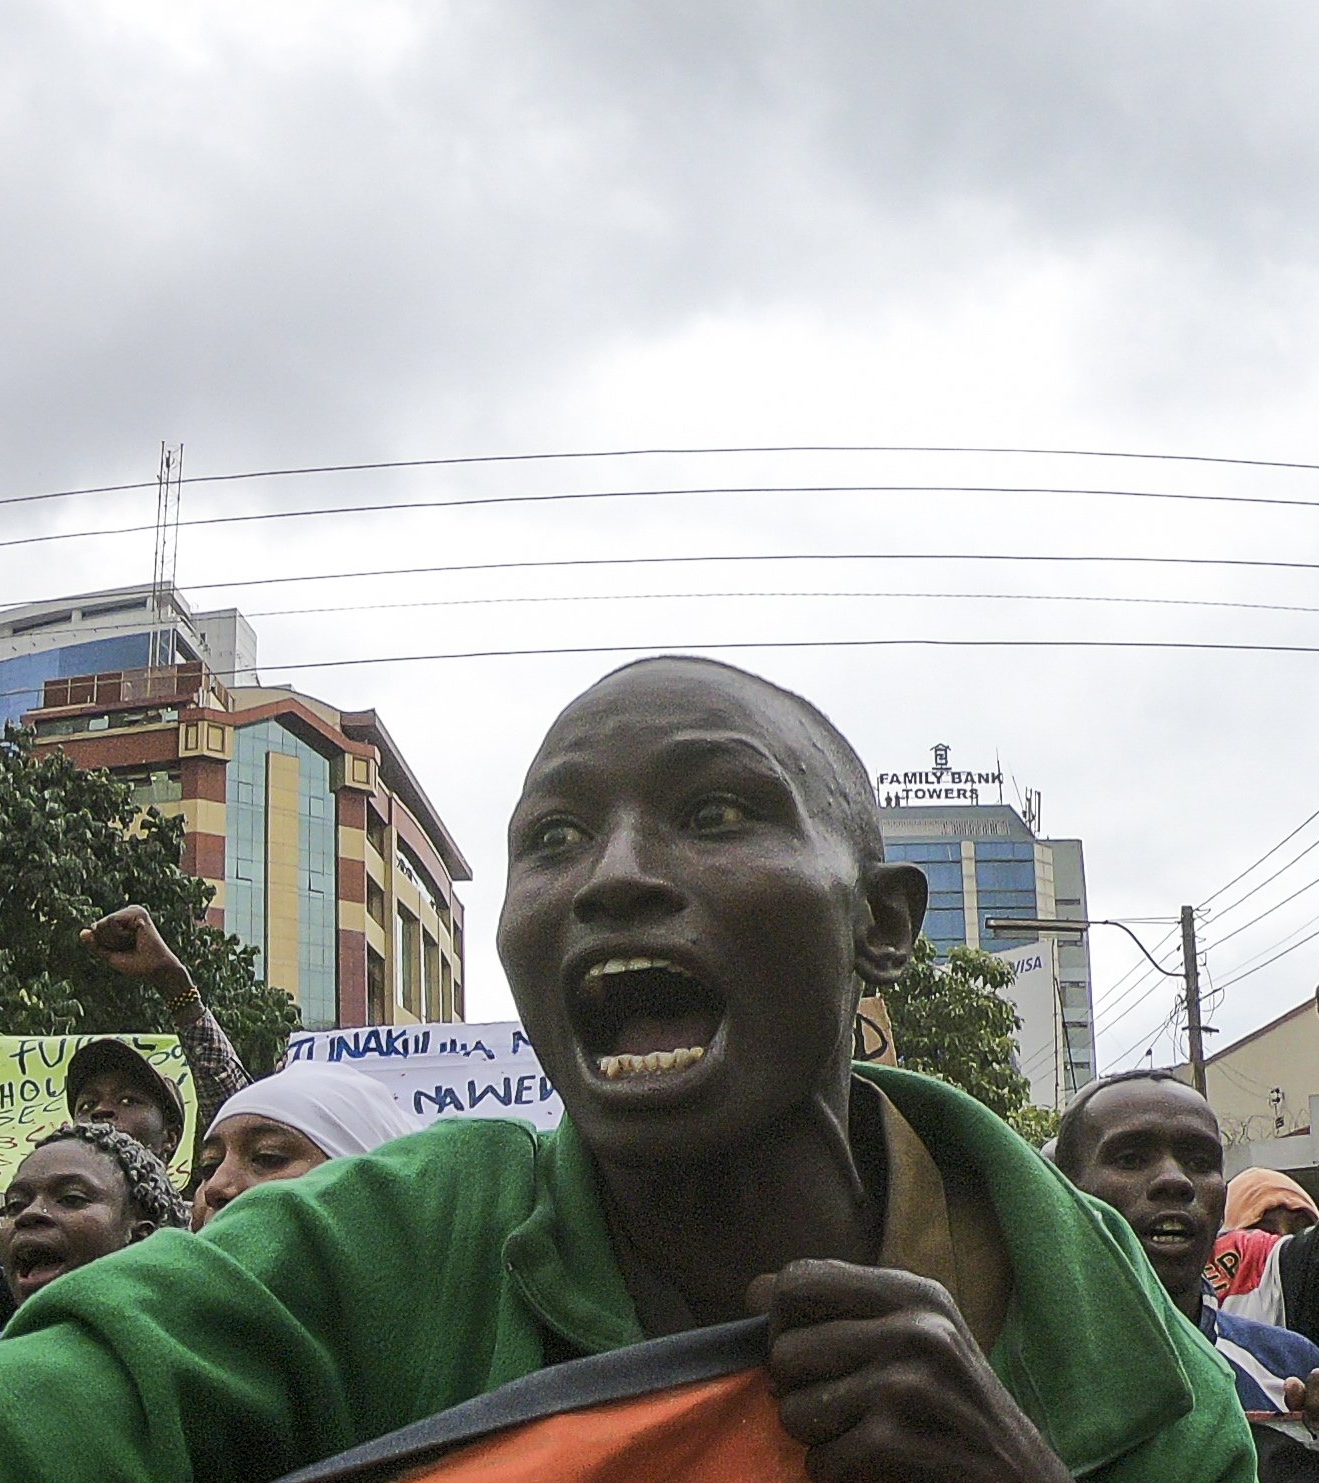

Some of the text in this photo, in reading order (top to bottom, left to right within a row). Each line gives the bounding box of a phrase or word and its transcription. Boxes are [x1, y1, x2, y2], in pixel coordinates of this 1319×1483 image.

[879, 770, 1004, 786] FAMILY BANK
[901, 787, 980, 801] TOWERS
